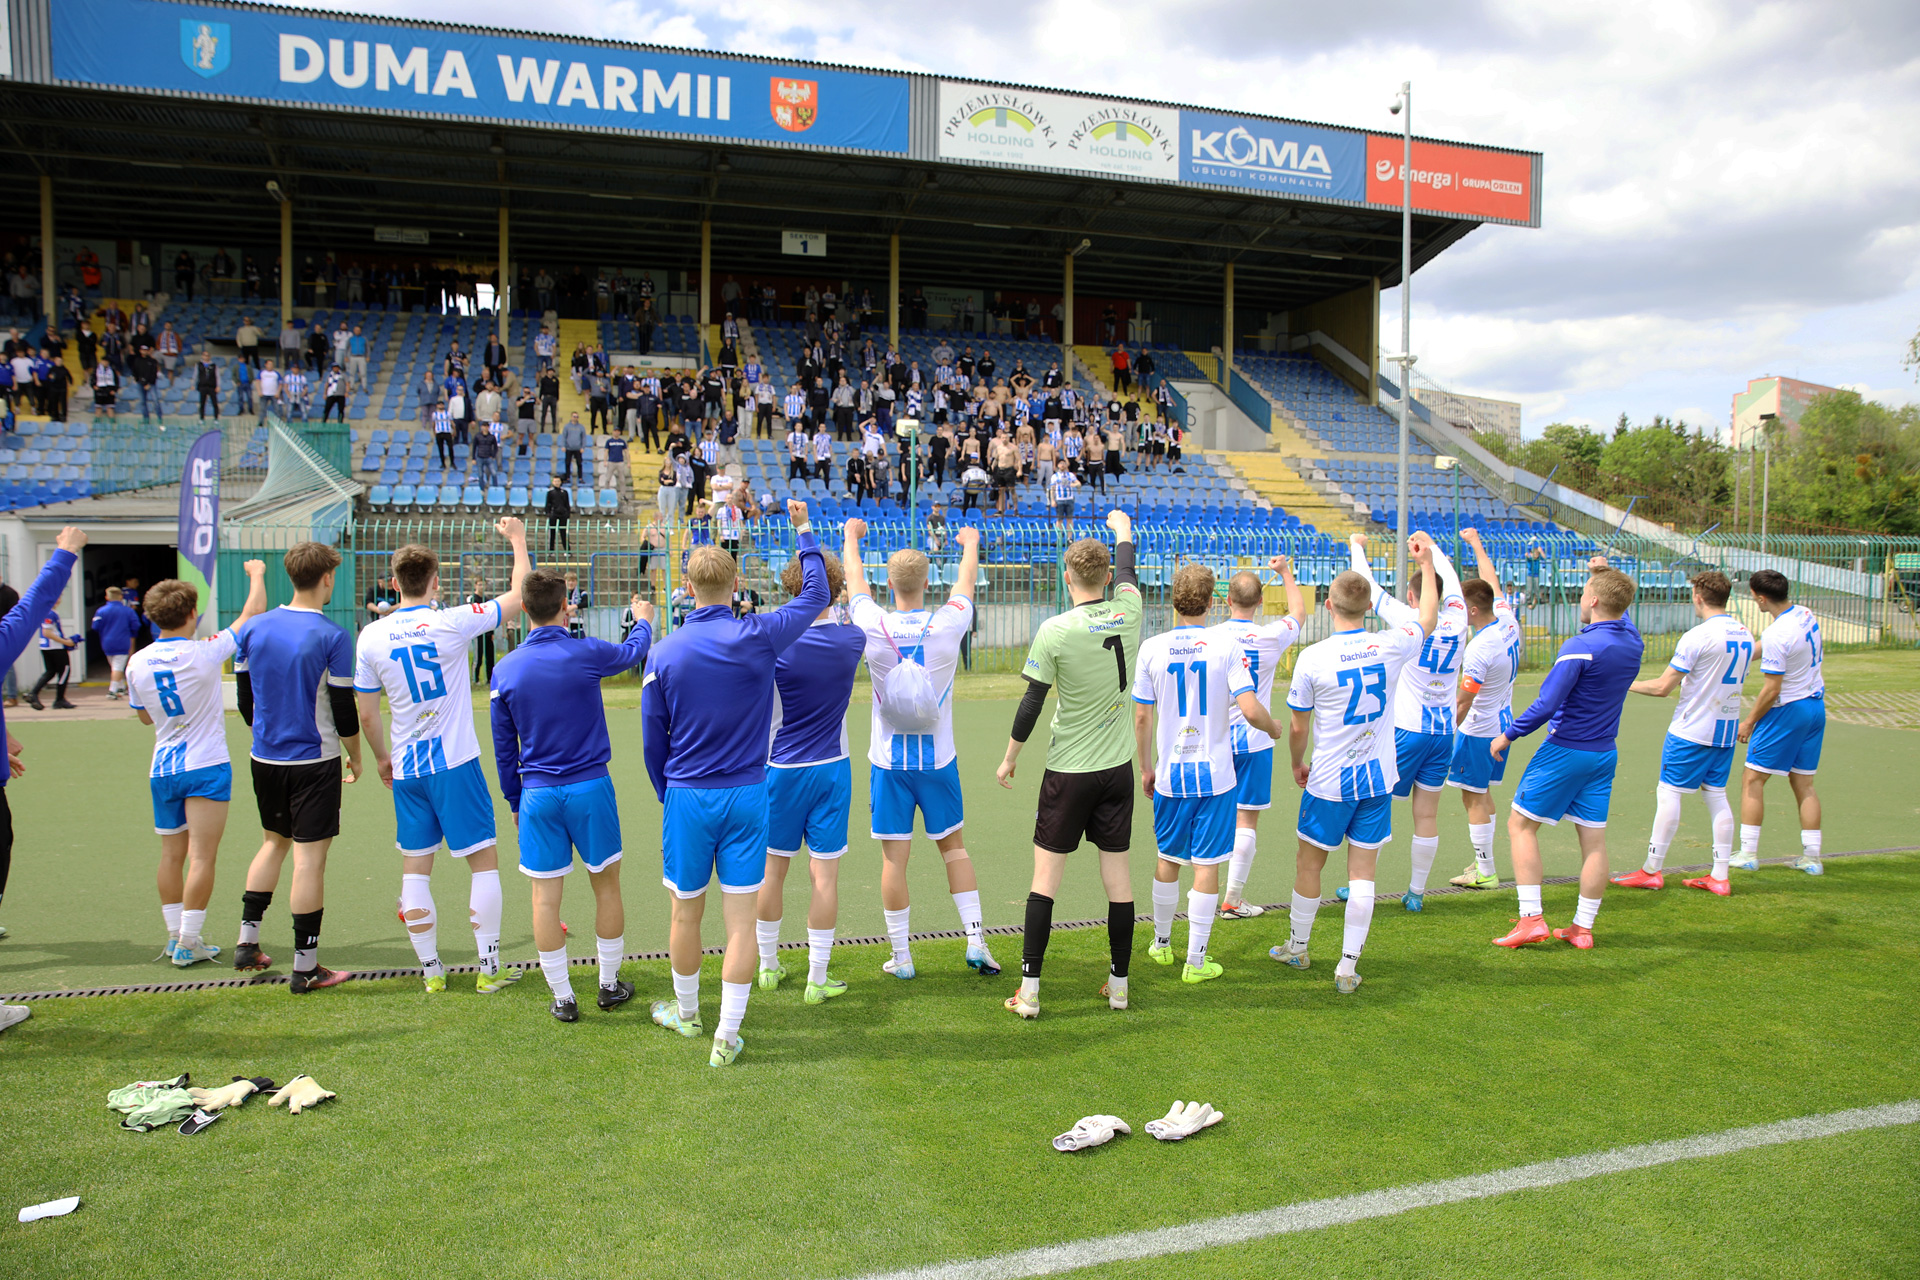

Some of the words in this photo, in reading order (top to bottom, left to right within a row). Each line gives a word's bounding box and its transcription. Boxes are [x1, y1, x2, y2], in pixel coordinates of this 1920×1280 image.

[279, 33, 478, 98] DUMA
[497, 54, 730, 120] WARMII
[944, 93, 1057, 149] PRZEMYSŁÓWKA
[1067, 107, 1175, 162] PRZEMYSŁÓWKA
[967, 132, 1034, 148] HOLDING
[1089, 145, 1153, 161] HOLDING
[1192, 125, 1332, 174] KOMA
[1192, 166, 1243, 178] USŁUGI
[1249, 172, 1332, 190] KOMUNALNE
[1398, 164, 1451, 190] Energa
[1462, 177, 1491, 190] GRUPA
[1492, 181, 1520, 193] ORLEN
[800, 240, 808, 253] 1
[389, 628, 427, 641] Dachland
[1088, 616, 1125, 634] Dachland
[1102, 634, 1128, 693] 1
[1169, 645, 1203, 656] Dachland
[1340, 648, 1378, 663] Dachland
[1418, 634, 1459, 674] 42
[389, 641, 447, 704] 15
[1166, 660, 1207, 718] 11
[1463, 679, 1470, 688] C
[153, 669, 186, 718] 8
[1336, 662, 1387, 726] 23
